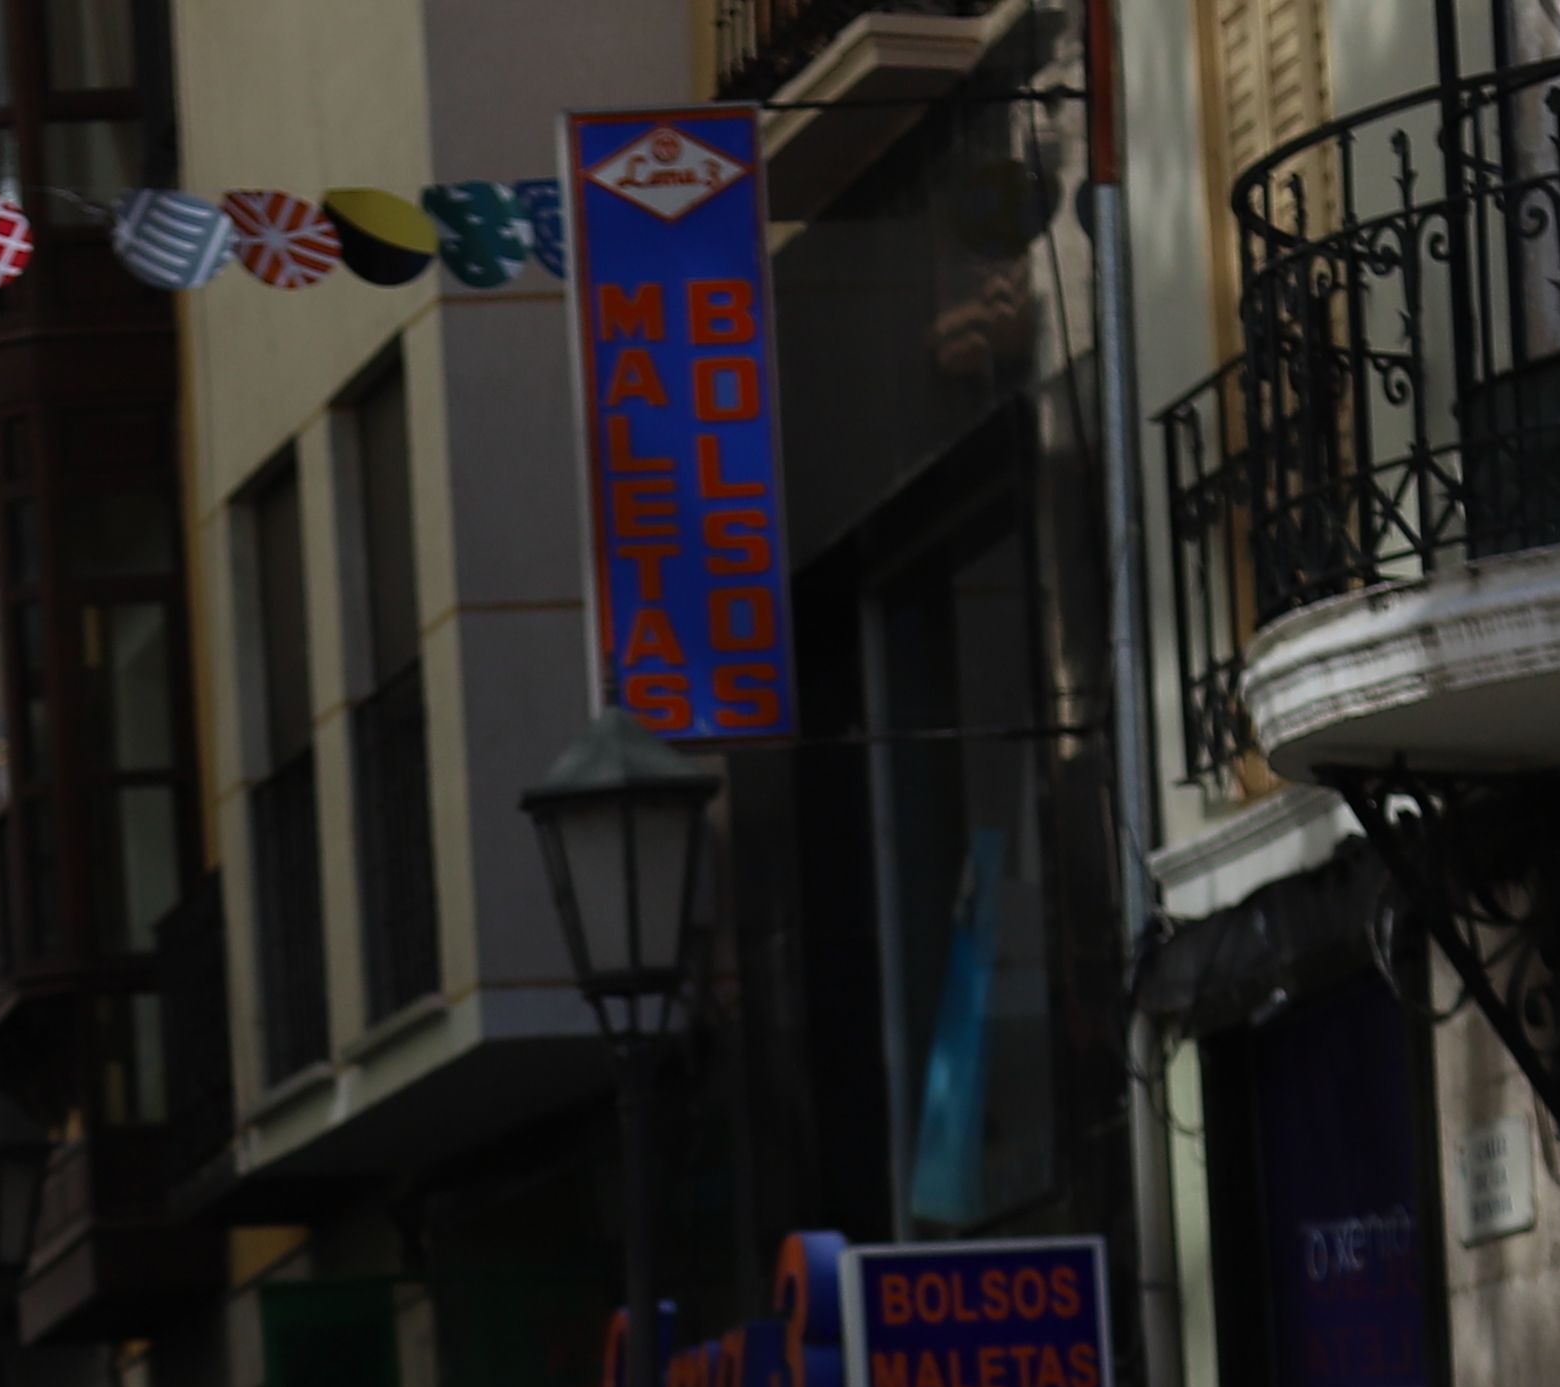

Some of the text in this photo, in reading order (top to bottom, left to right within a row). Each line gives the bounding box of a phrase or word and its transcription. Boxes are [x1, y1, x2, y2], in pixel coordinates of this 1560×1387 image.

[601, 284, 688, 728] MALETAS
[691, 281, 780, 727] BOLSOS
[880, 1264, 1081, 1327] BOLSOS
